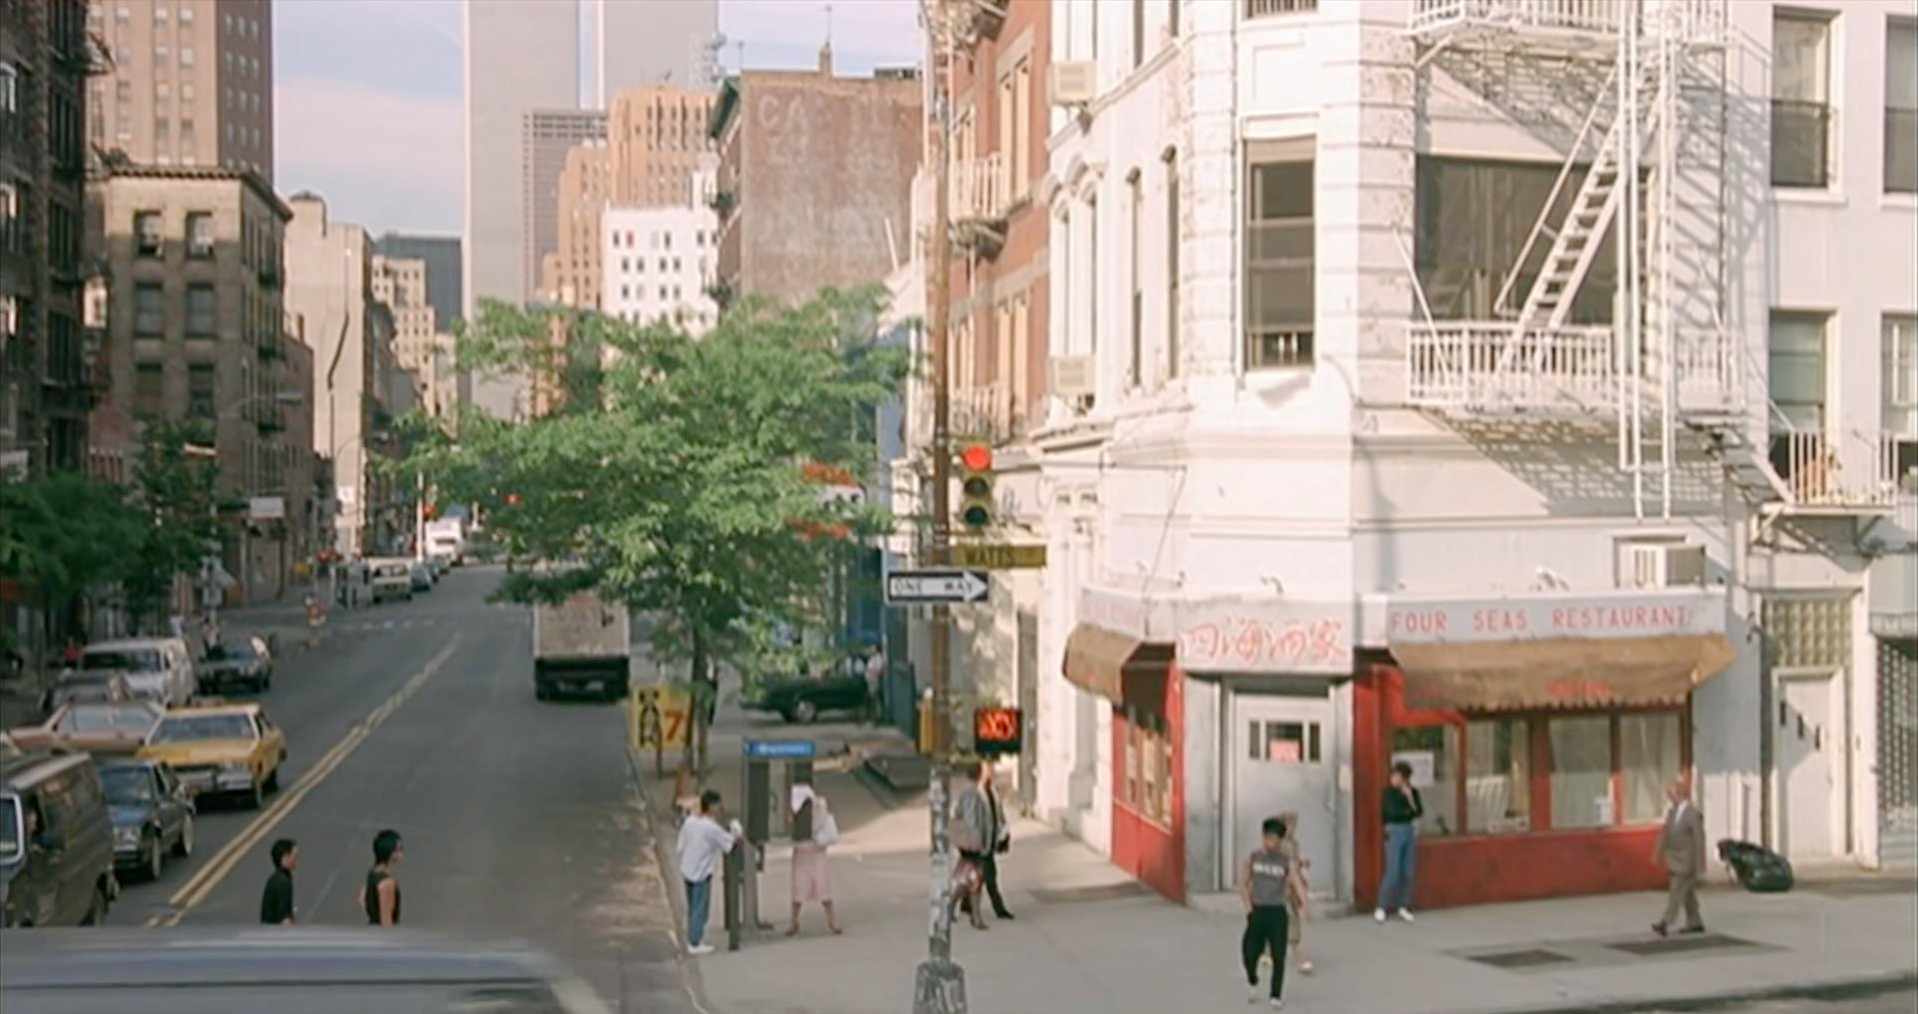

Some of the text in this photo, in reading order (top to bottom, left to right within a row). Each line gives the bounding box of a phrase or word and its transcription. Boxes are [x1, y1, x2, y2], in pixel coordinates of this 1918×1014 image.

[965, 547, 1015, 566] WATTS
[894, 578, 974, 592] ONE WAY
[1390, 605, 1690, 634] FOUR SEAS RESTAURANT
[1177, 615, 1347, 664] 四海酒家
[664, 709, 684, 741] 7
